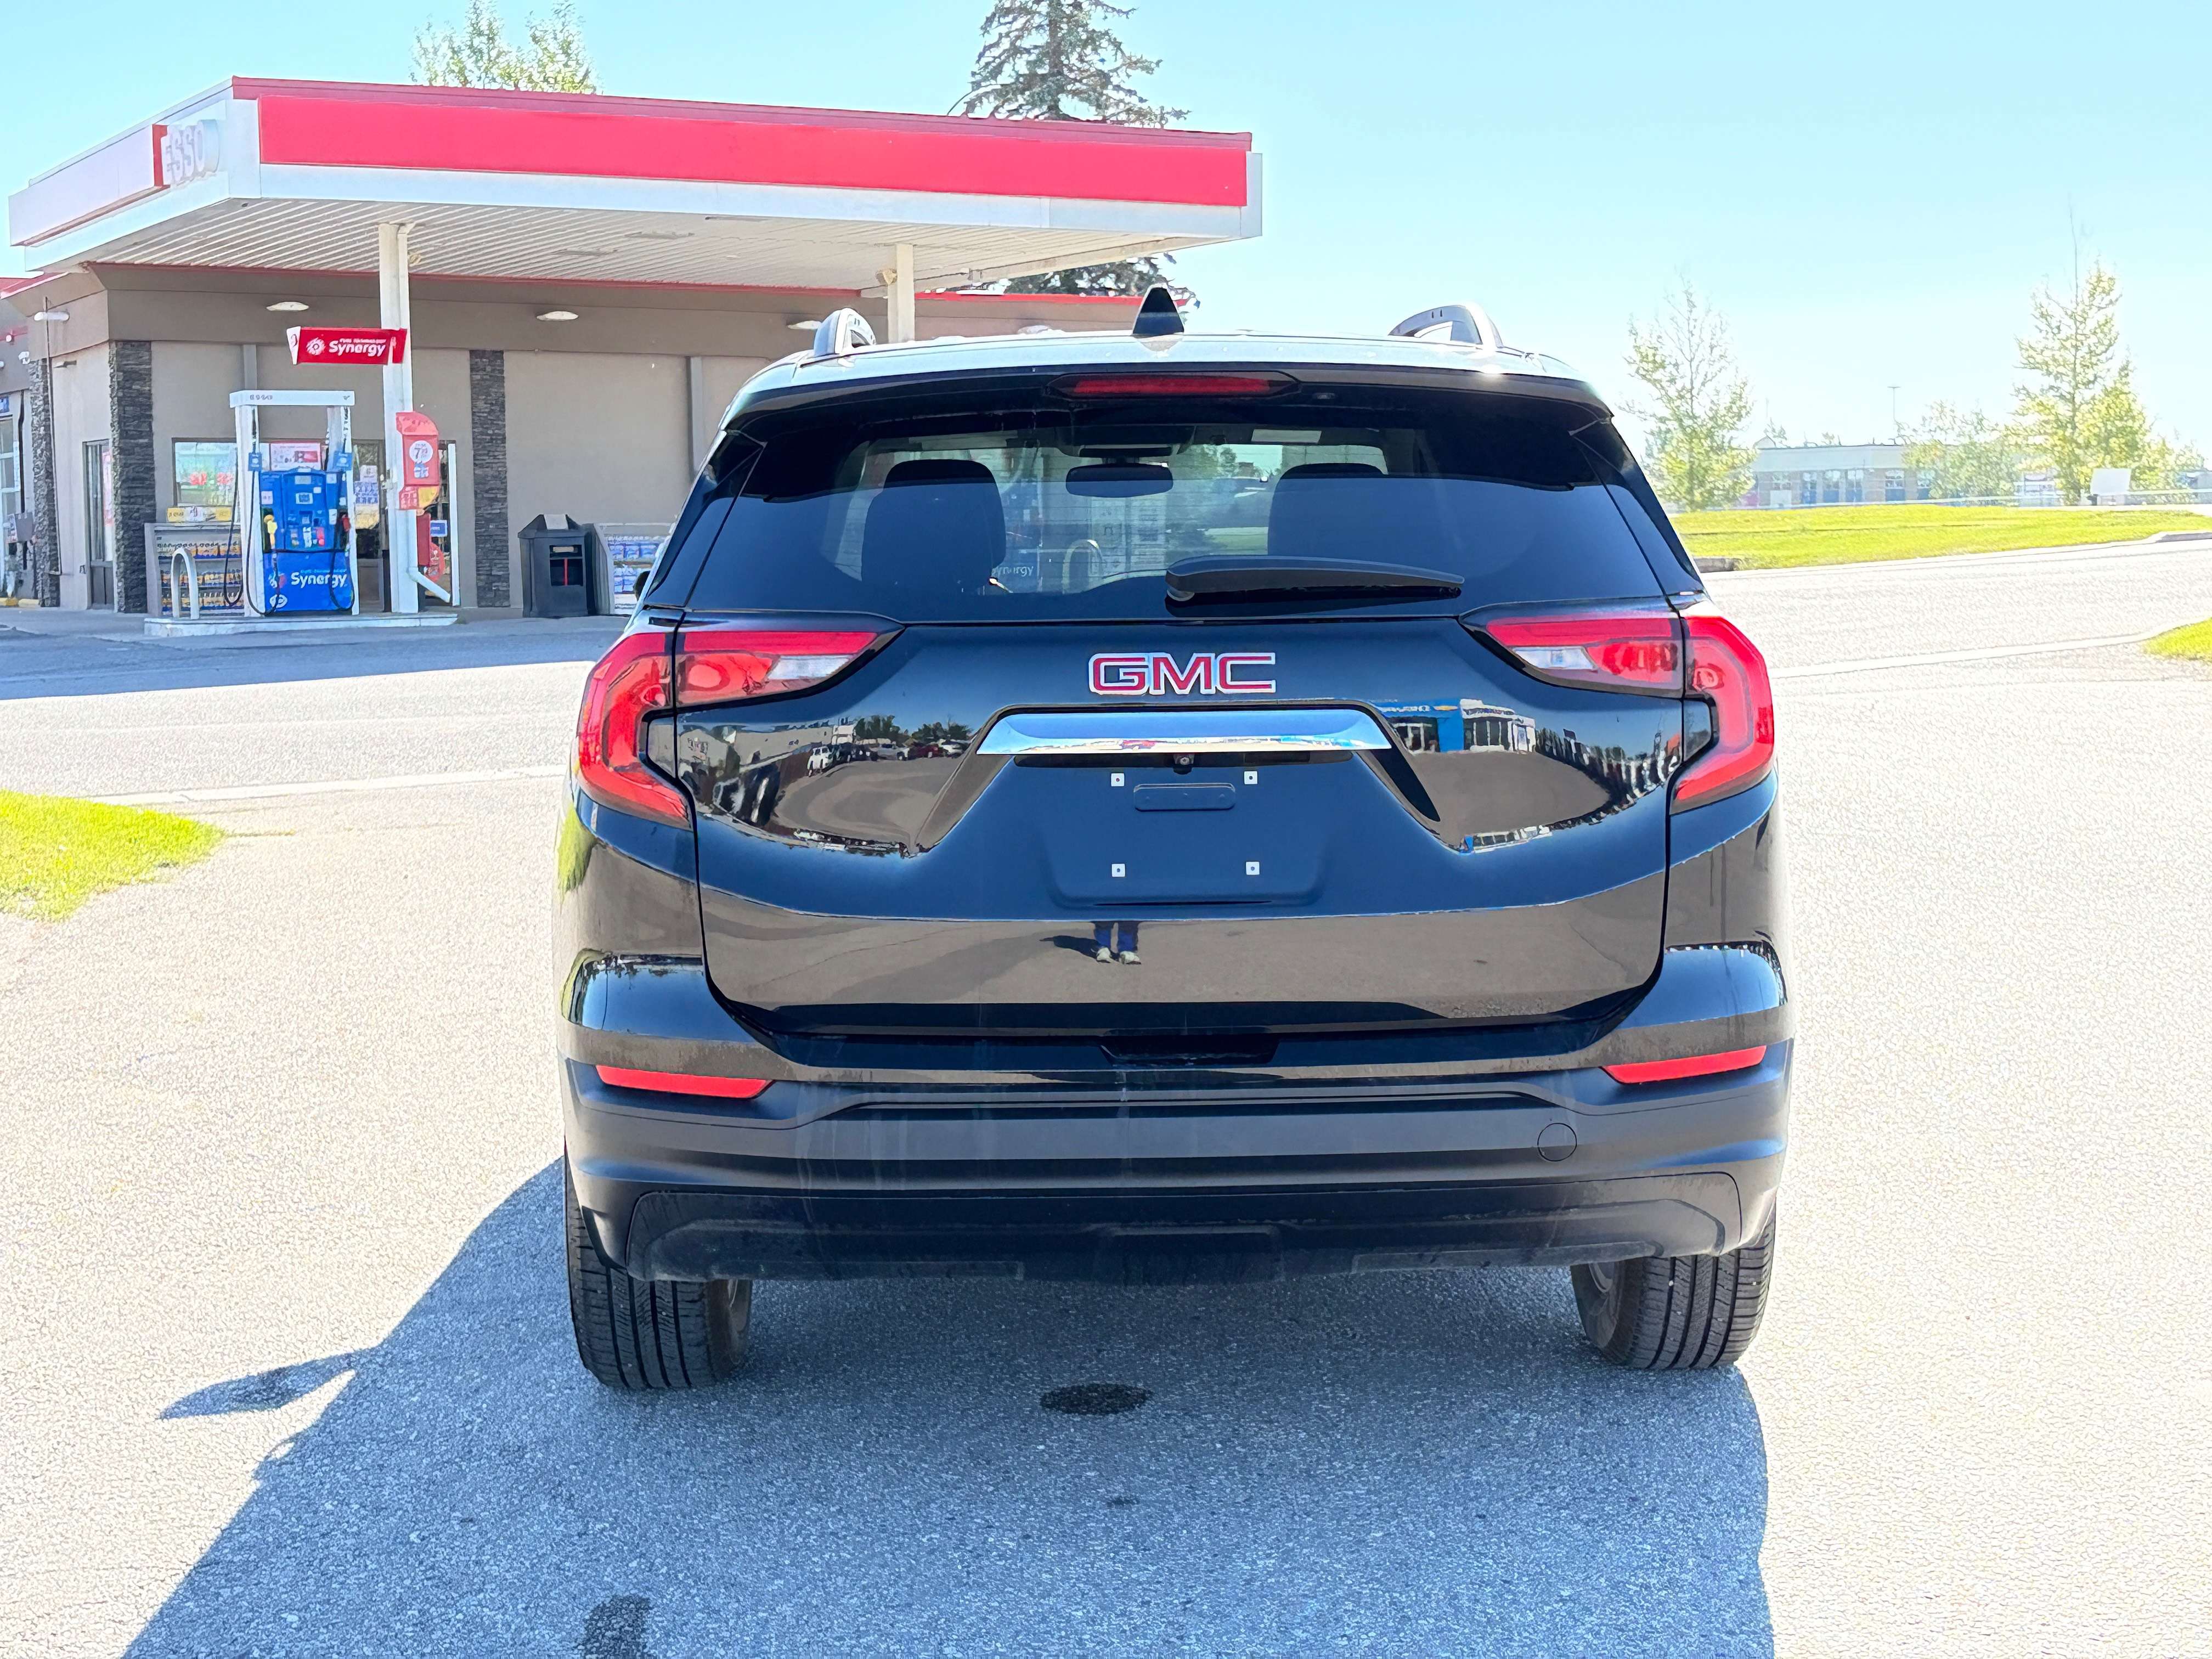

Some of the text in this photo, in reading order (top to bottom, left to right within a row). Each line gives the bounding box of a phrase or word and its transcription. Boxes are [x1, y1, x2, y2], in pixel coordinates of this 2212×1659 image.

[329, 340, 386, 357] Synergy
[291, 572, 347, 588] Synergy
[1088, 652, 1276, 695] GMC
